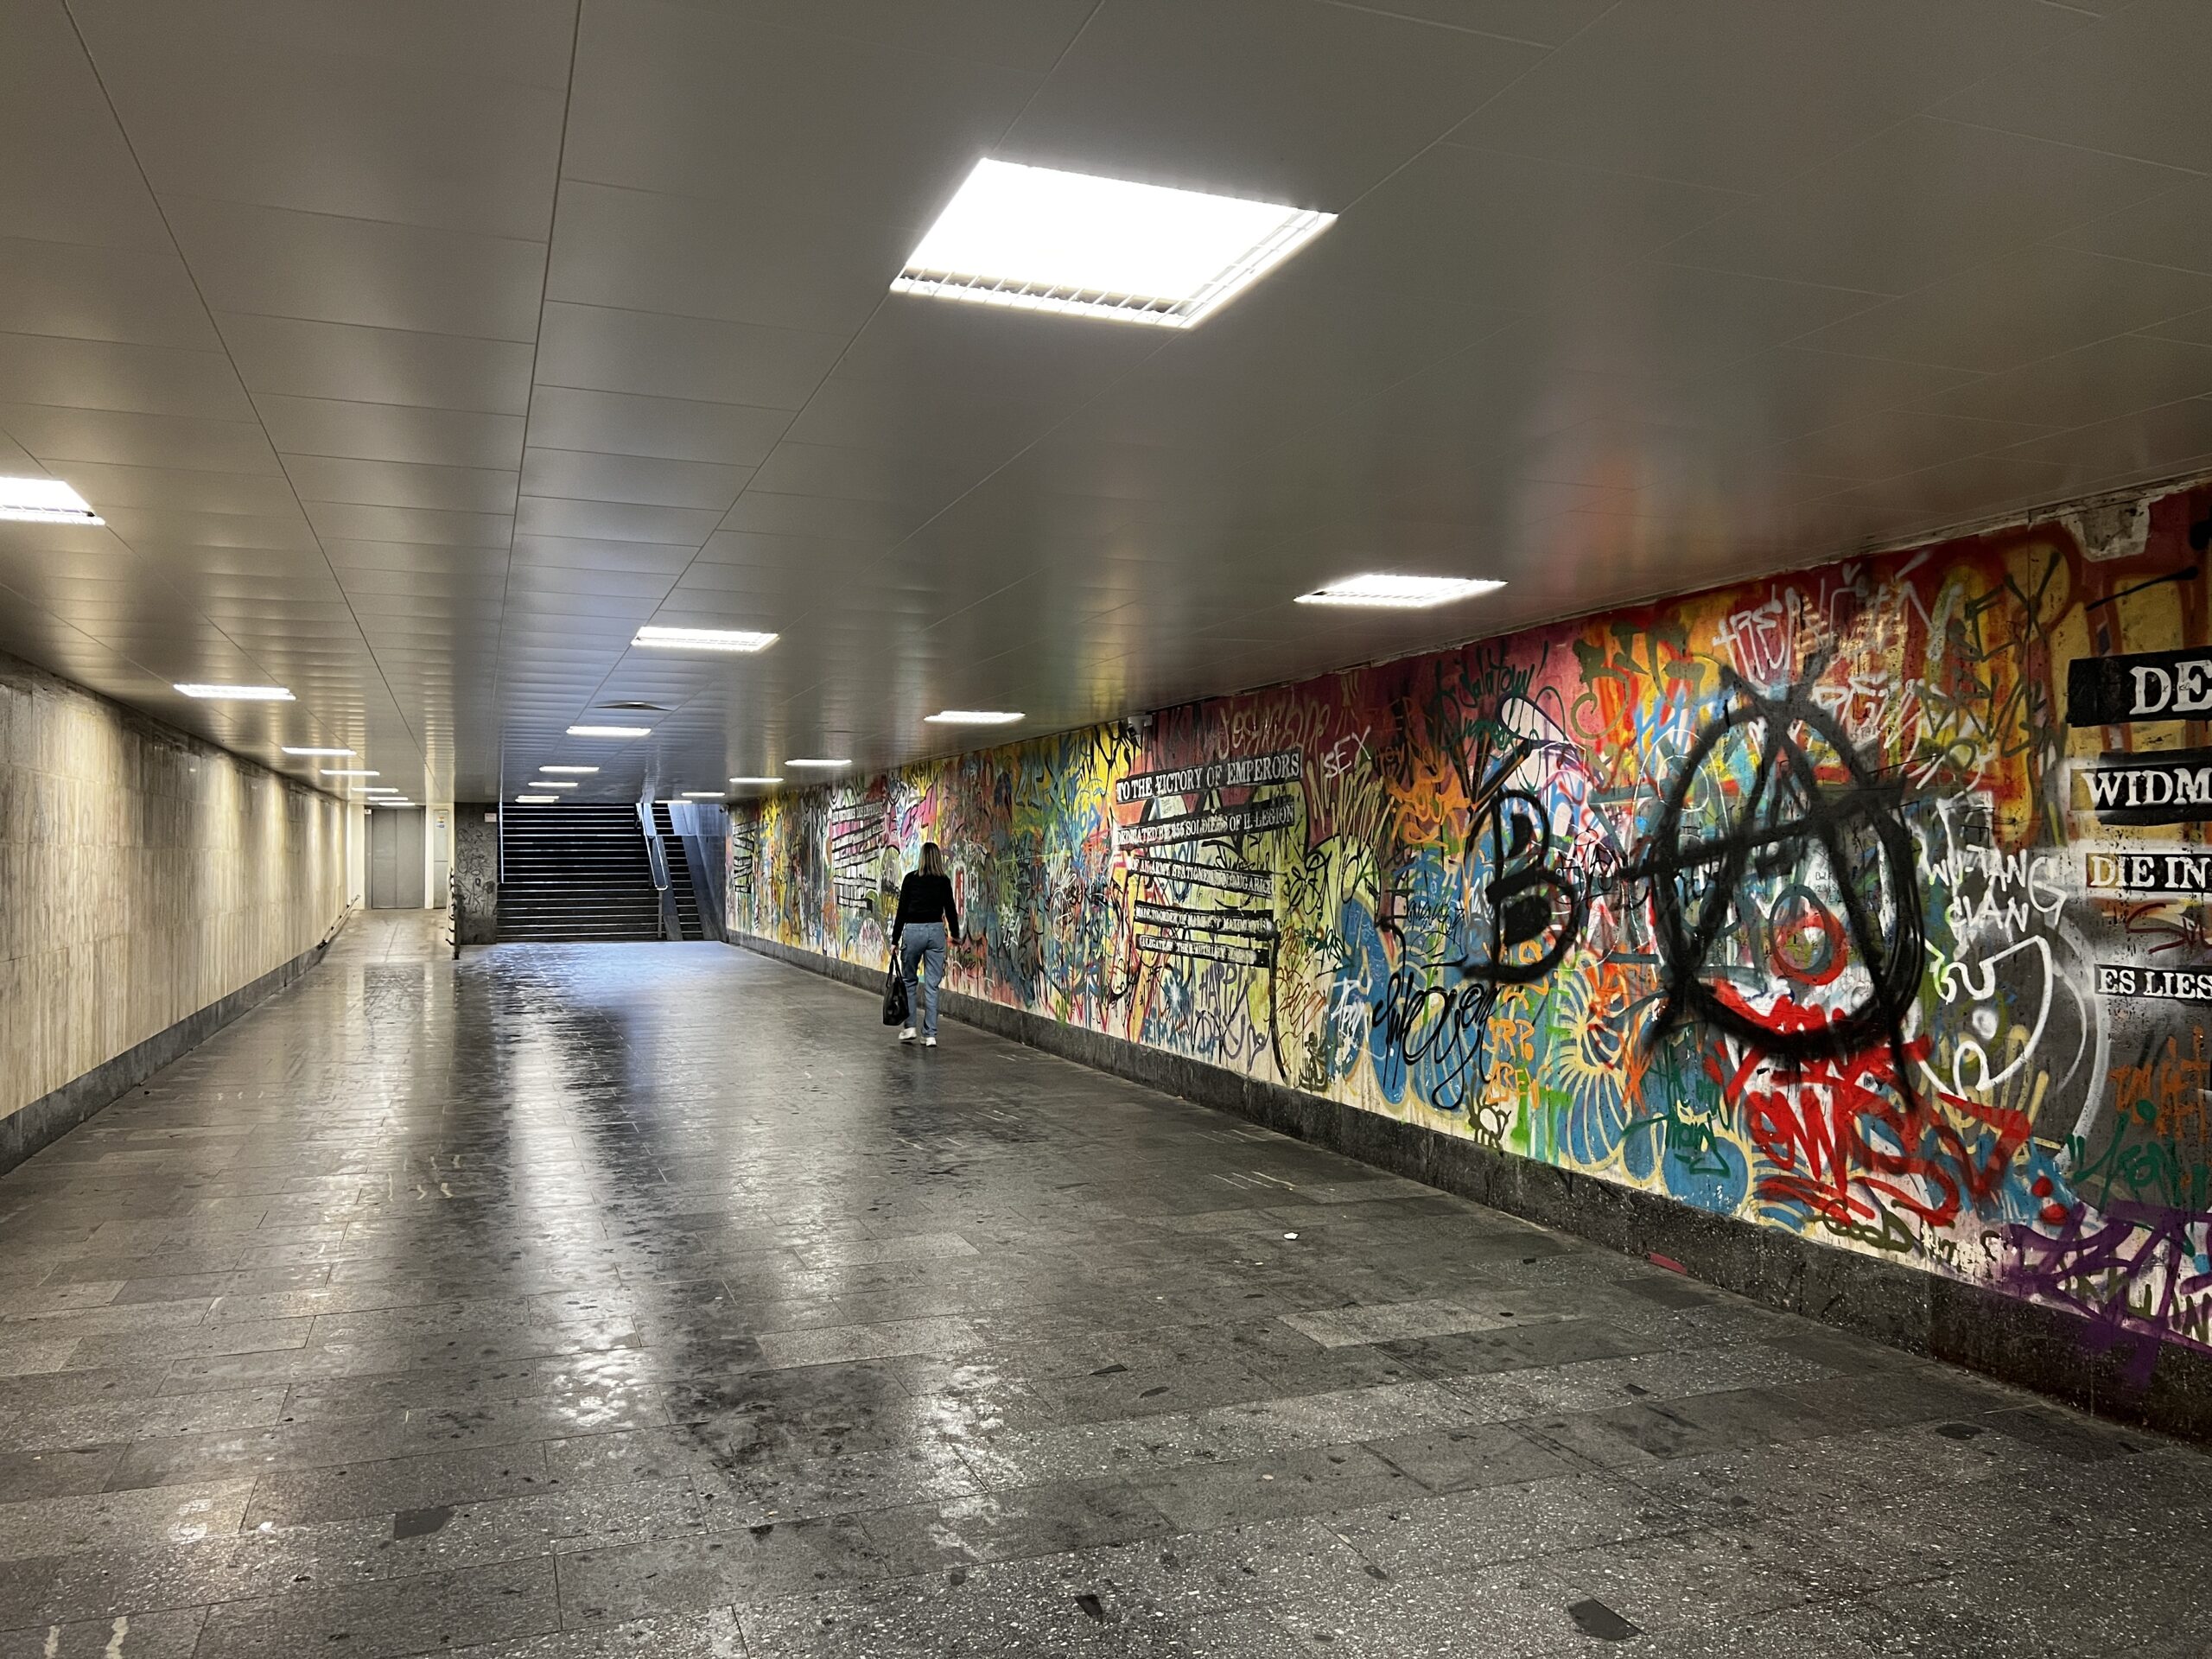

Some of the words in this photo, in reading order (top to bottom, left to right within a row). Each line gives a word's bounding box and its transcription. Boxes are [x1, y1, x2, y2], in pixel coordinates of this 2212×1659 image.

[1324, 725, 1372, 779] SEX
[1116, 781, 1130, 802] TO
[1131, 776, 1153, 798] THE
[1155, 767, 1203, 795] VICTORY
[1206, 765, 1223, 788] OF
[1227, 753, 1300, 785] EMPERORS
[1229, 814, 1242, 832] OF
[1255, 804, 1294, 828] LEGION
[2090, 855, 2155, 887] DIE
[2098, 968, 2136, 994] ES
